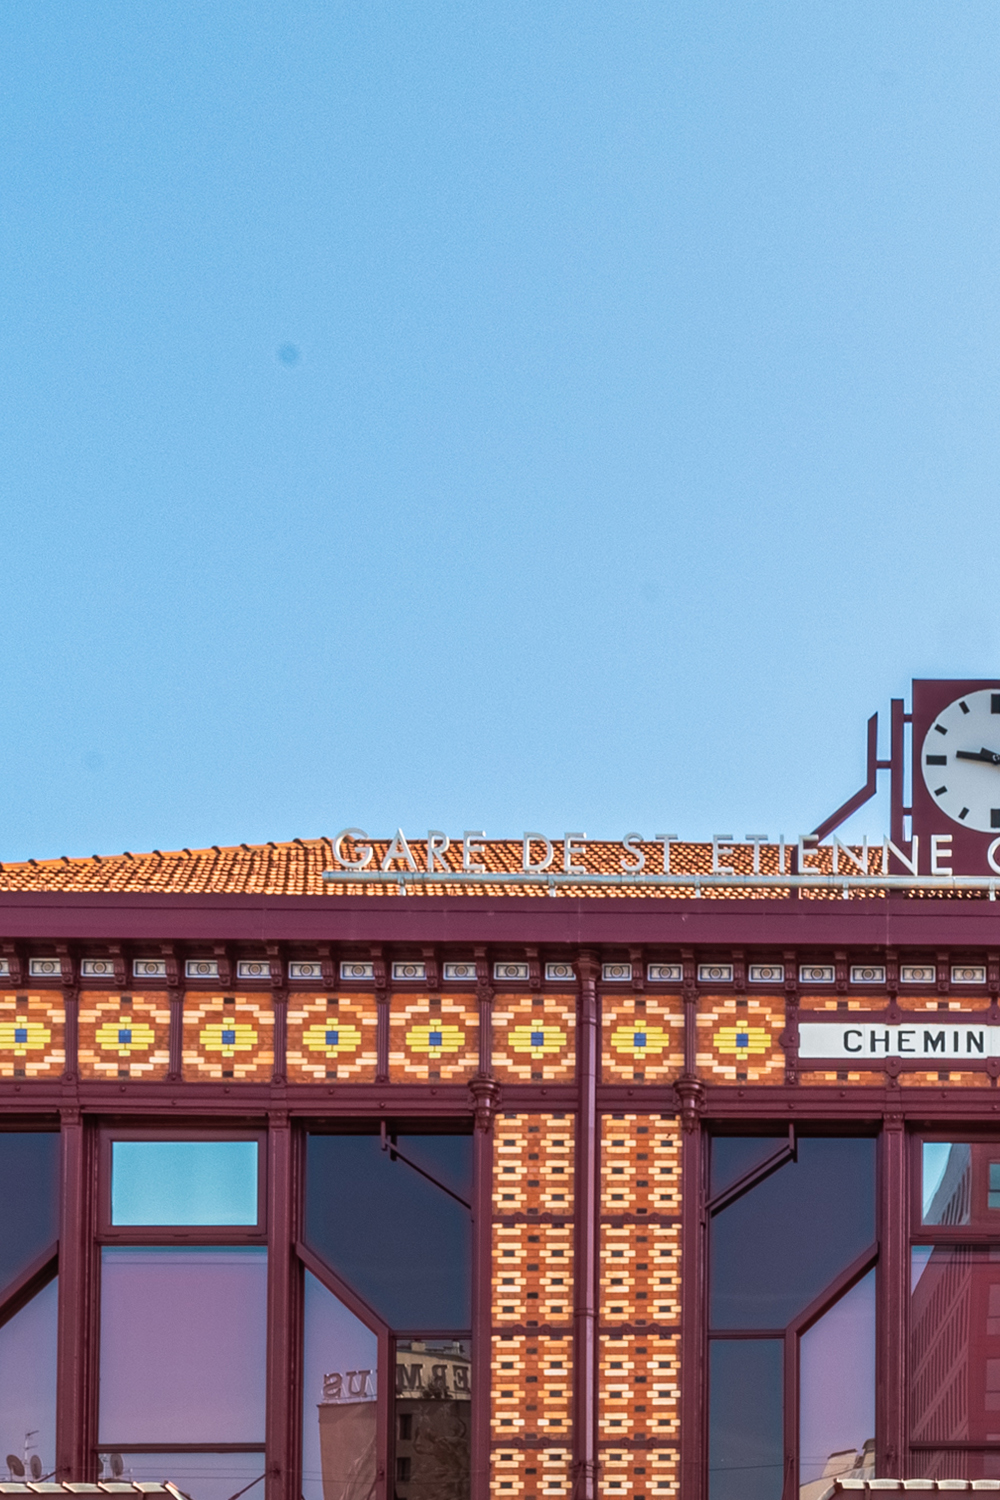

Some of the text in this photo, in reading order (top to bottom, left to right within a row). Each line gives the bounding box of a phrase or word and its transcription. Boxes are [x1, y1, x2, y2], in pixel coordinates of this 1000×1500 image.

[332, 827, 487, 872] GARE
[521, 831, 587, 873] DE
[620, 832, 679, 873] ST
[711, 833, 953, 877] ETIENNE
[842, 1029, 986, 1056] CHEMIN
